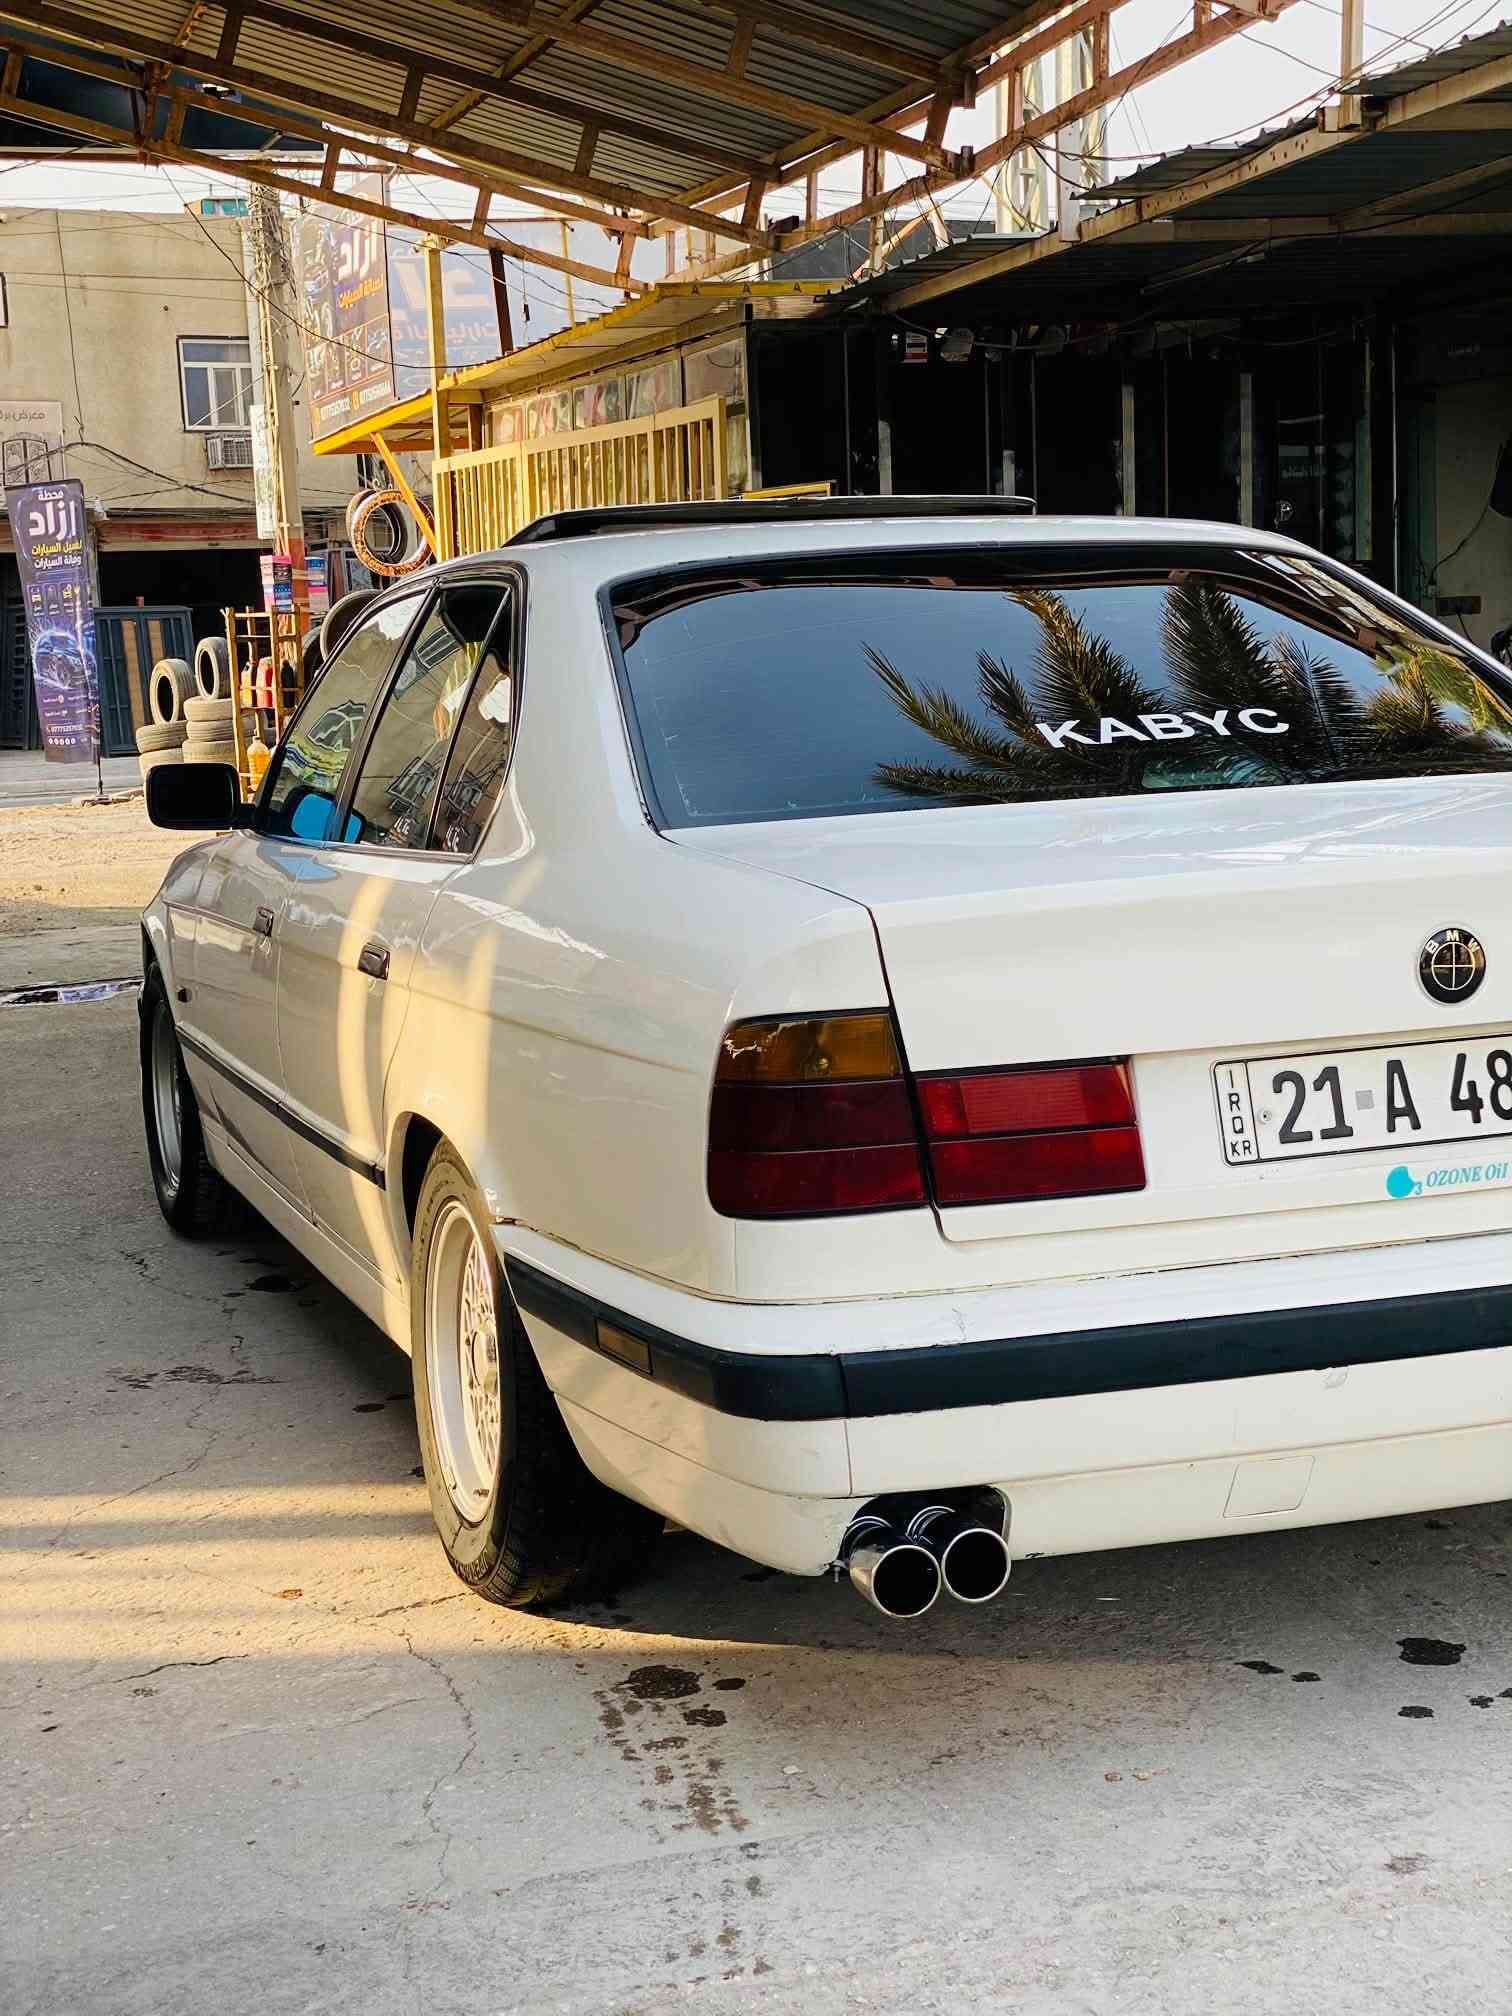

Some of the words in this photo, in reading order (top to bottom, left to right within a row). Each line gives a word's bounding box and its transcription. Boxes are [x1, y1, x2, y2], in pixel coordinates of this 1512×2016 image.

[32, 543, 61, 557] السيارات
[34, 556, 62, 569] السيارات
[1034, 708, 1290, 748] KABYC
[1424, 930, 1481, 955] BMW
[1271, 1065, 1354, 1144] 21
[1386, 1058, 1422, 1133] A
[1230, 1140, 1253, 1157] KR
[1426, 1166, 1483, 1187] OZONE
